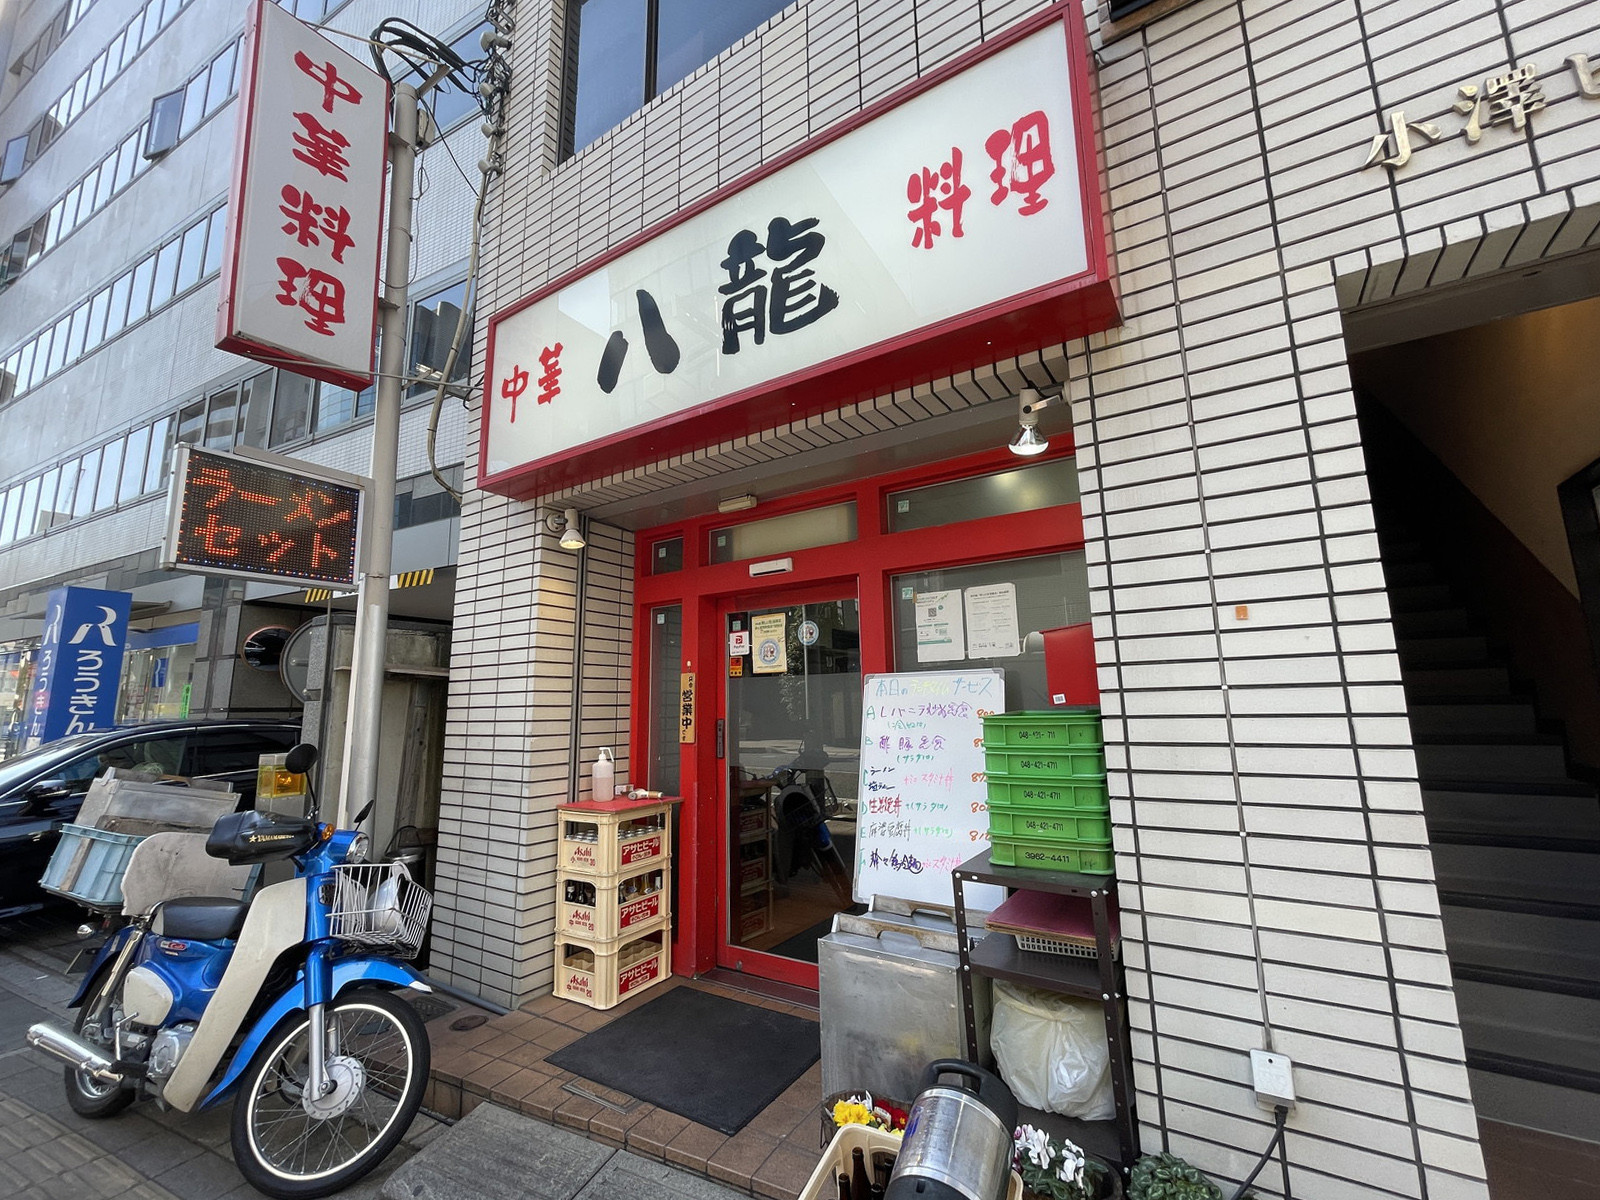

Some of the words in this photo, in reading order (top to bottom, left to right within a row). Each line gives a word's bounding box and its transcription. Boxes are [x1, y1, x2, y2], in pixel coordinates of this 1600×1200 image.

[275, 50, 363, 337] 中華料理
[501, 341, 563, 424] 中華
[596, 216, 840, 394] 八龍
[906, 109, 1056, 249] 料理
[193, 467, 351, 529] ラーメン
[194, 513, 340, 568] セット
[866, 705, 876, 720] A
[574, 846, 592, 858] Asahi
[622, 838, 660, 856] アサヒビール
[572, 909, 591, 922] Asahi
[621, 897, 659, 918] アサヒビール
[570, 974, 589, 987] Asahi
[620, 959, 658, 984] アサヒビール
